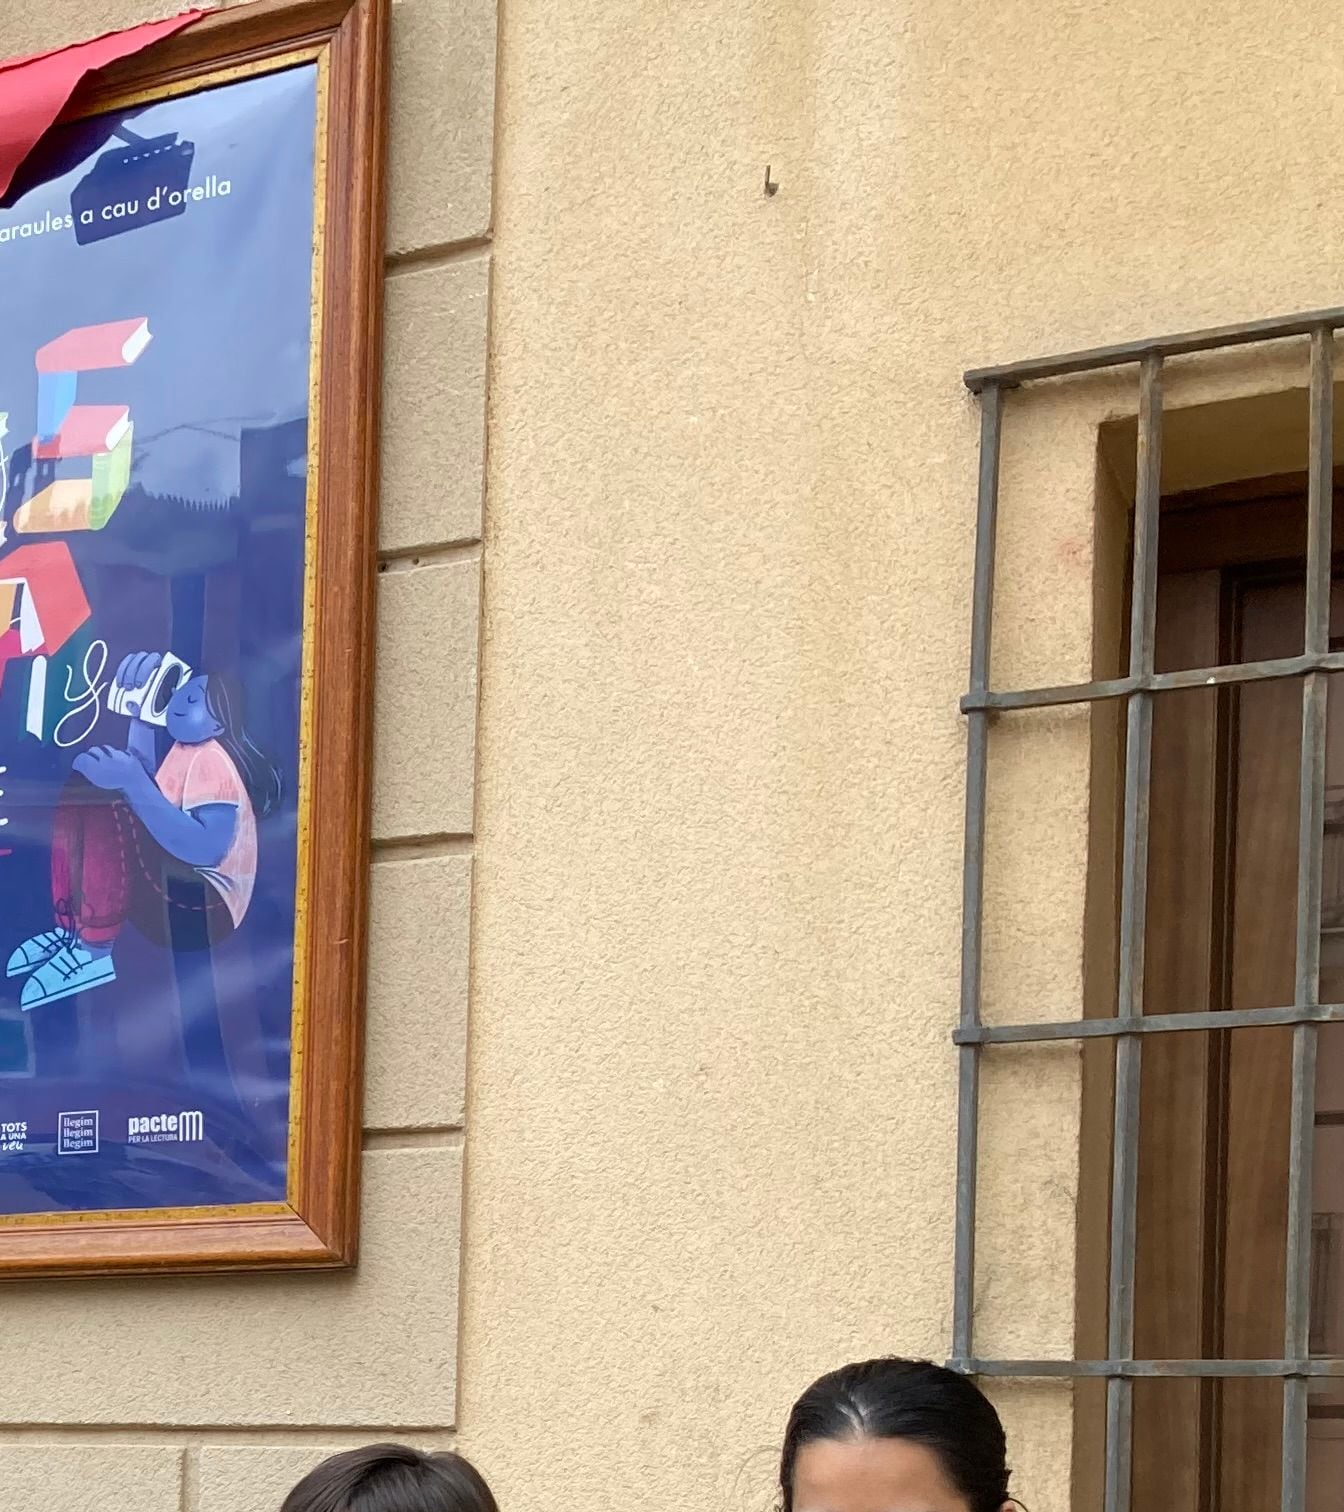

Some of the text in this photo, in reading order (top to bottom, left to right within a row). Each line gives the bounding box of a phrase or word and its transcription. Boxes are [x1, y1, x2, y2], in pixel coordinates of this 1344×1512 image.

[80, 209, 93, 224] a
[102, 199, 138, 220] cau
[147, 175, 231, 211] d'orella
[1, 1122, 27, 1132] TOTS
[0, 1132, 27, 1141] A UNA
[128, 1135, 141, 1144] PER
[151, 1133, 178, 1142] LECTURA
[2, 1140, 23, 1151] veu
